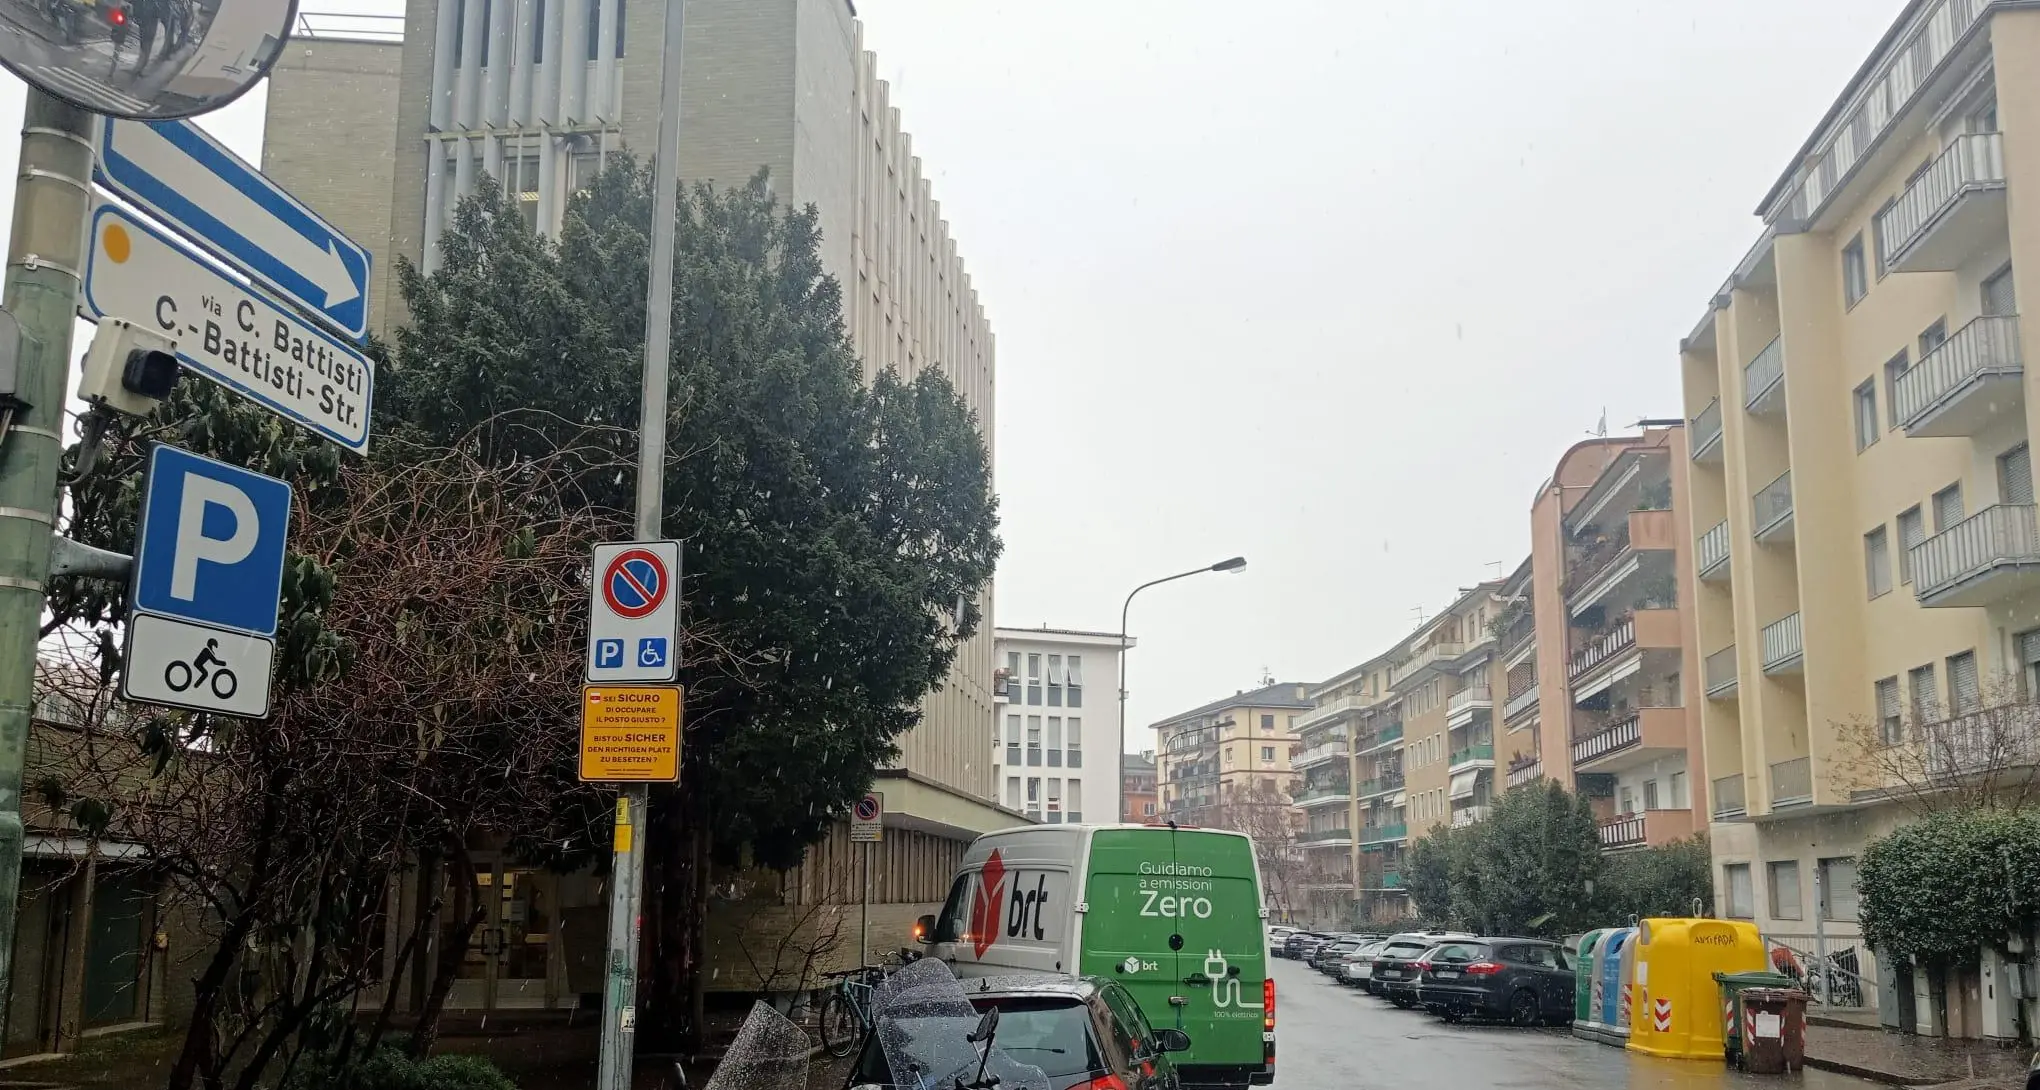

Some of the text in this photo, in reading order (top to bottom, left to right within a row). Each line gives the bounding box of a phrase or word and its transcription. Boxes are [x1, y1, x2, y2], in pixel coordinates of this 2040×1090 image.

[201, 294, 363, 396] via C. Battisti
[155, 294, 358, 430] C.-Battisti-Str.
[170, 471, 260, 602] P
[601, 641, 619, 666] P
[618, 693, 661, 703] SICURO
[605, 706, 657, 714] DI OCCUPARE
[625, 733, 666, 743] SICHER
[605, 746, 647, 754] RICHTIGEN
[648, 746, 671, 754] PLATZ
[1139, 861, 1213, 877] Guidiamo
[1139, 878, 1213, 892] a emissioni
[1007, 870, 1049, 941] brt
[1139, 890, 1213, 919] Zero
[1142, 960, 1159, 971] brt
